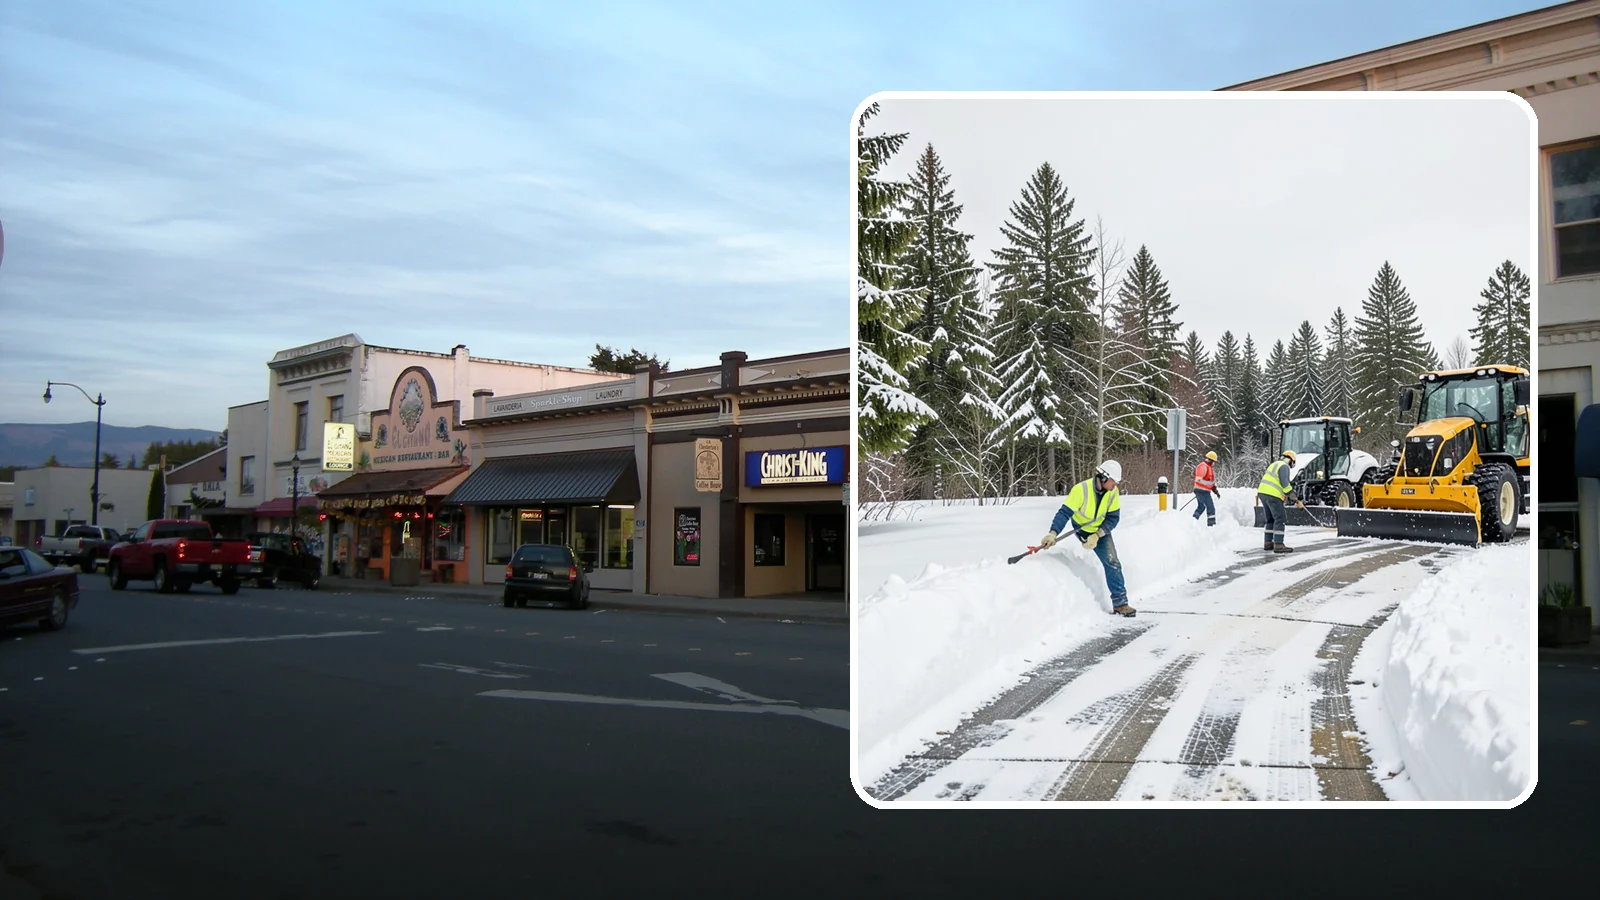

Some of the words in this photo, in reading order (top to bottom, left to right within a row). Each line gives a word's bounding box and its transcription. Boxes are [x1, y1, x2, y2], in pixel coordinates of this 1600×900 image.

[595, 389, 623, 400] LAUNDRY
[493, 402, 522, 413] LAVANDERIA
[531, 398, 560, 409] Sparkle
[562, 395, 582, 405] Shop
[391, 425, 401, 450] EL
[373, 454, 396, 464] MEXICAN
[397, 451, 433, 463] RESTAURANT
[437, 450, 450, 459] BAR
[761, 452, 797, 478] CHRIST
[799, 449, 828, 476] KING
[697, 480, 709, 489] Coffee
